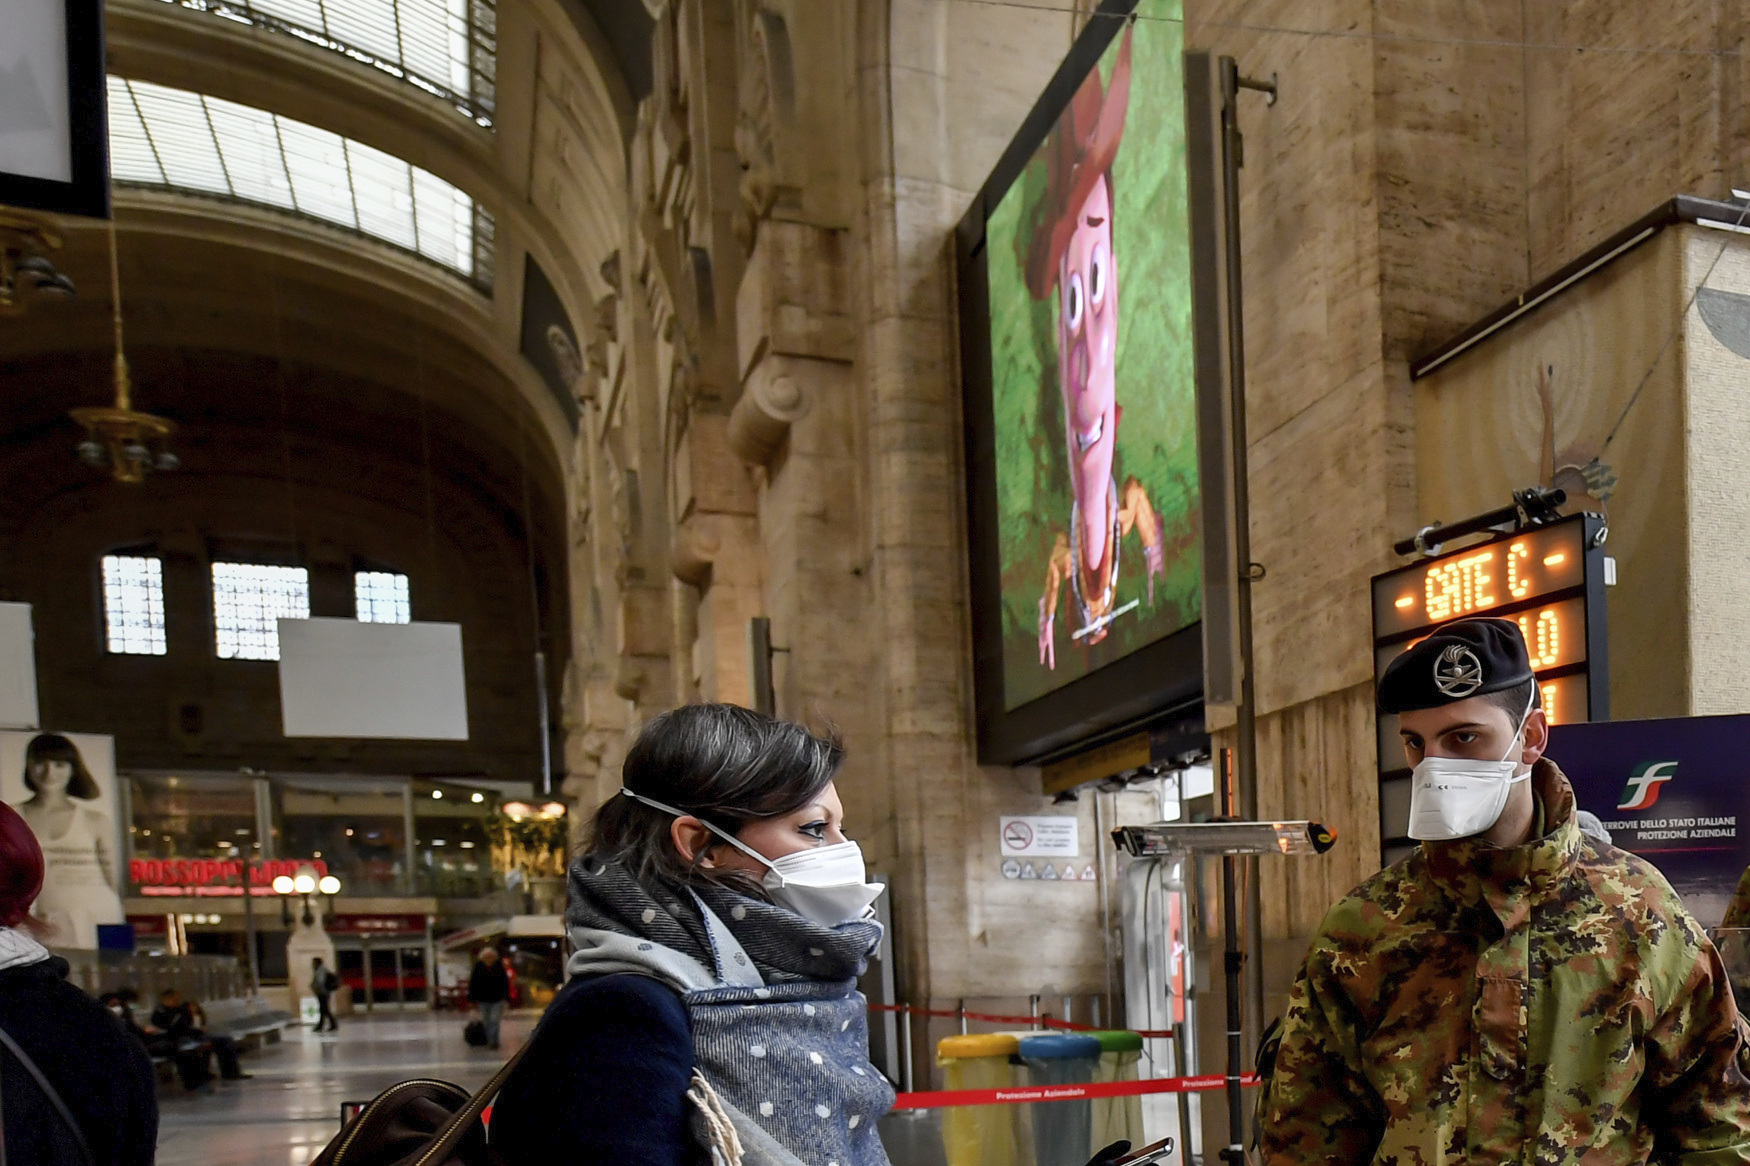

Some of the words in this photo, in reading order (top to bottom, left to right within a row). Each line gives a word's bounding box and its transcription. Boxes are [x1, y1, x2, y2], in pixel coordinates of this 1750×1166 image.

[1425, 552, 1494, 619] GATE
[1507, 543, 1528, 596] C
[1602, 820, 1638, 830] ERROVIE
[1640, 818, 1667, 829] DELLO
[1669, 818, 1696, 828] STATO
[1697, 816, 1736, 826] ITALIANE
[1637, 830, 1688, 841] PROTEZIONE
[1690, 828, 1736, 838] AZIENDALE
[996, 1091, 1042, 1100] Protezione
